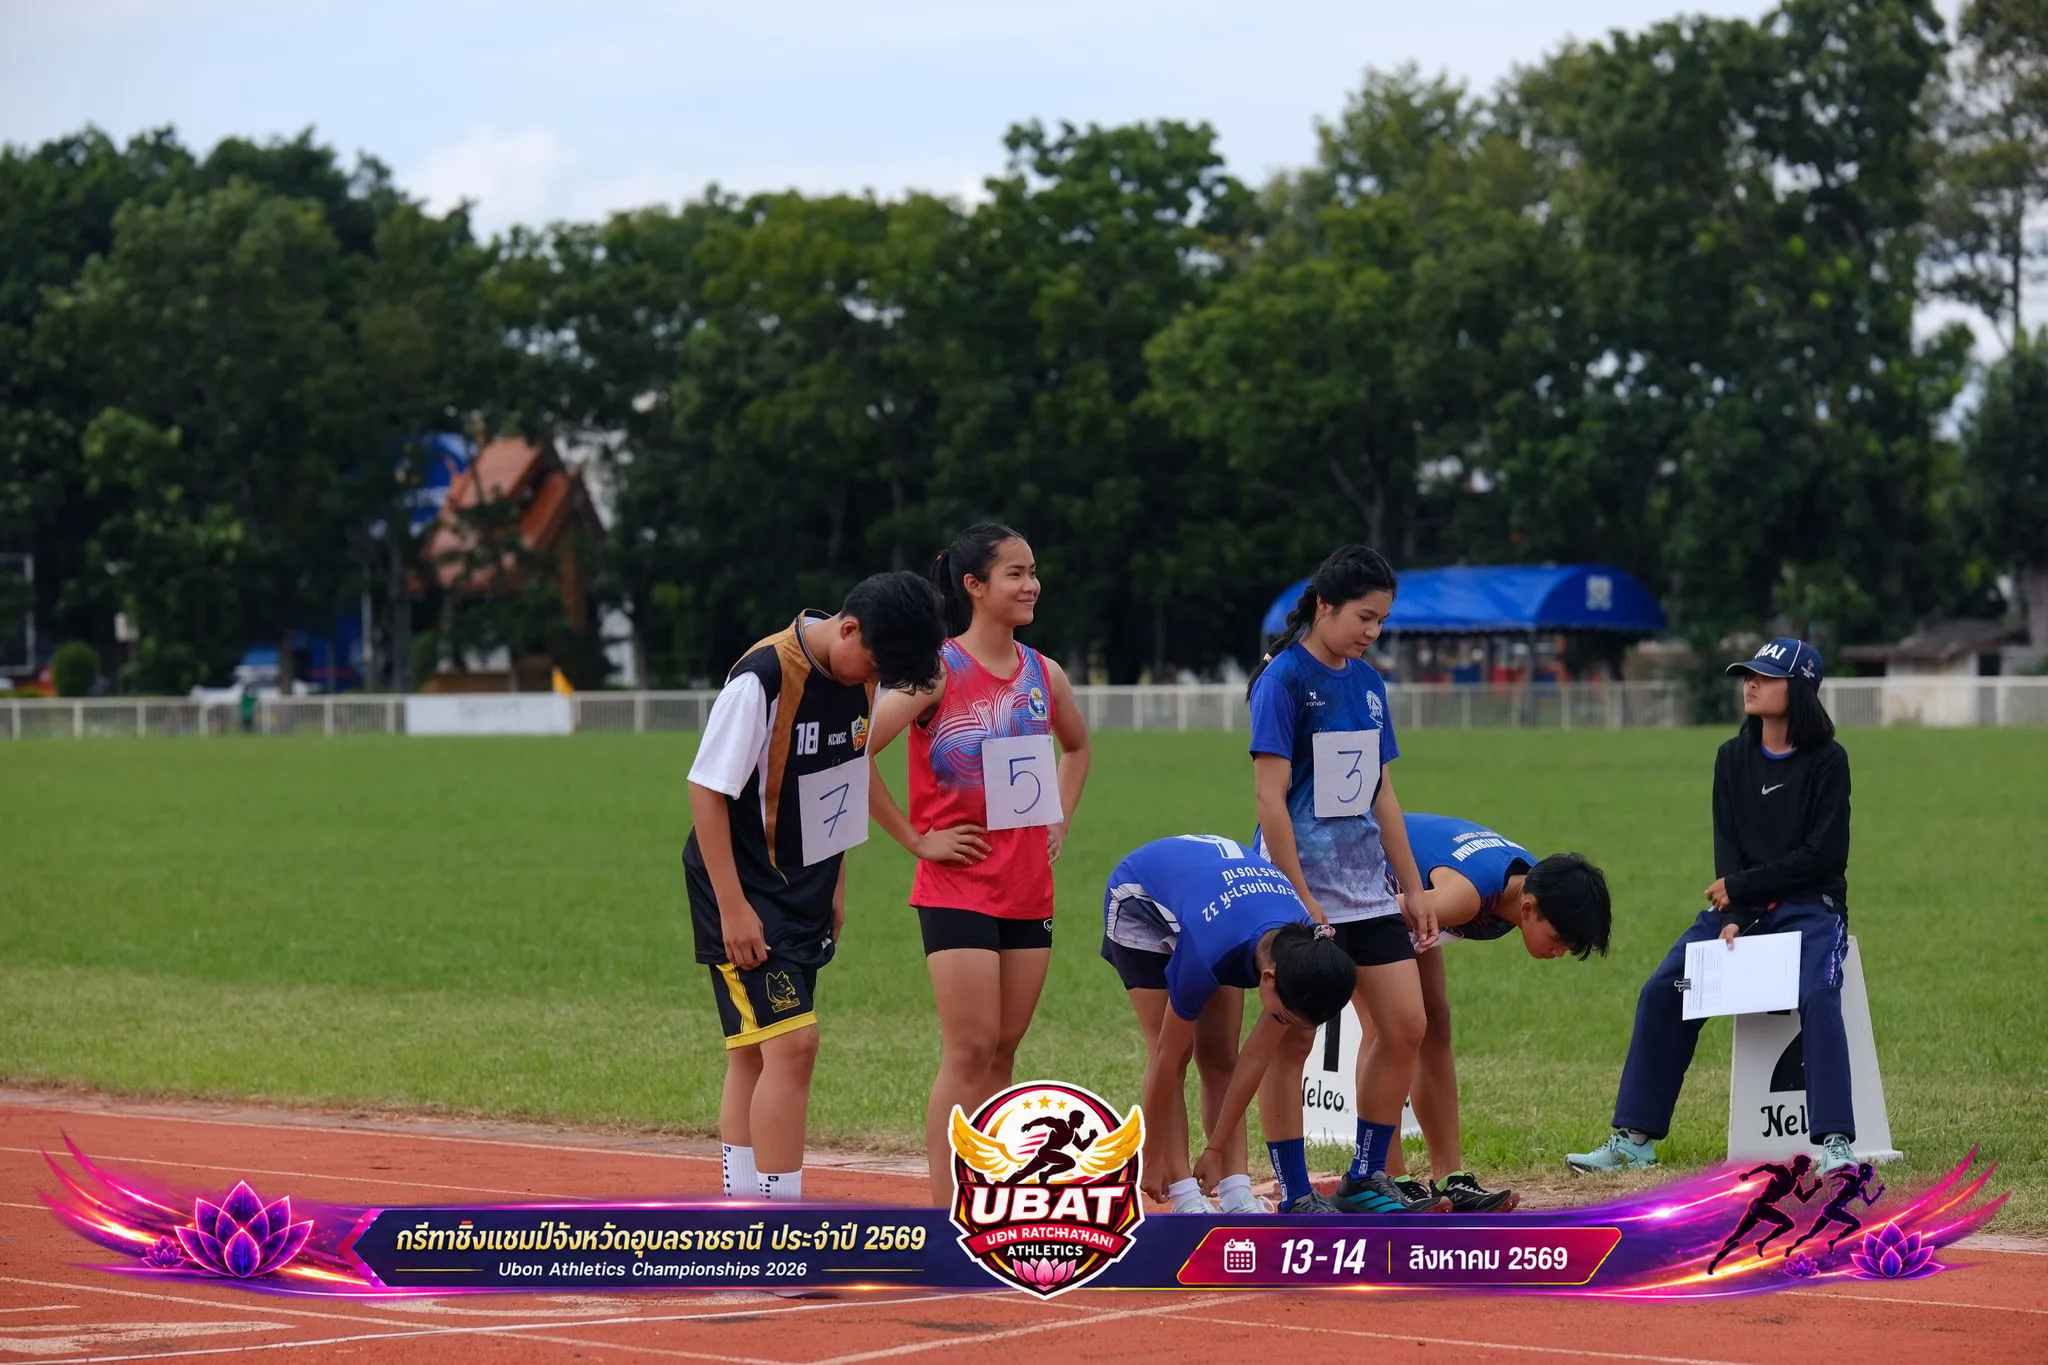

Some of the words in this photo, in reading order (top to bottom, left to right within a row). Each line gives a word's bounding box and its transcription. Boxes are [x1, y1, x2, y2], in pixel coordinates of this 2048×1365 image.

[795, 720, 820, 756] 18
[1008, 755, 1042, 815] 5
[1335, 748, 1364, 804] 3
[818, 782, 850, 838] 7
[1202, 901, 1219, 922] 32
[1760, 1104, 1809, 1138] Nel
